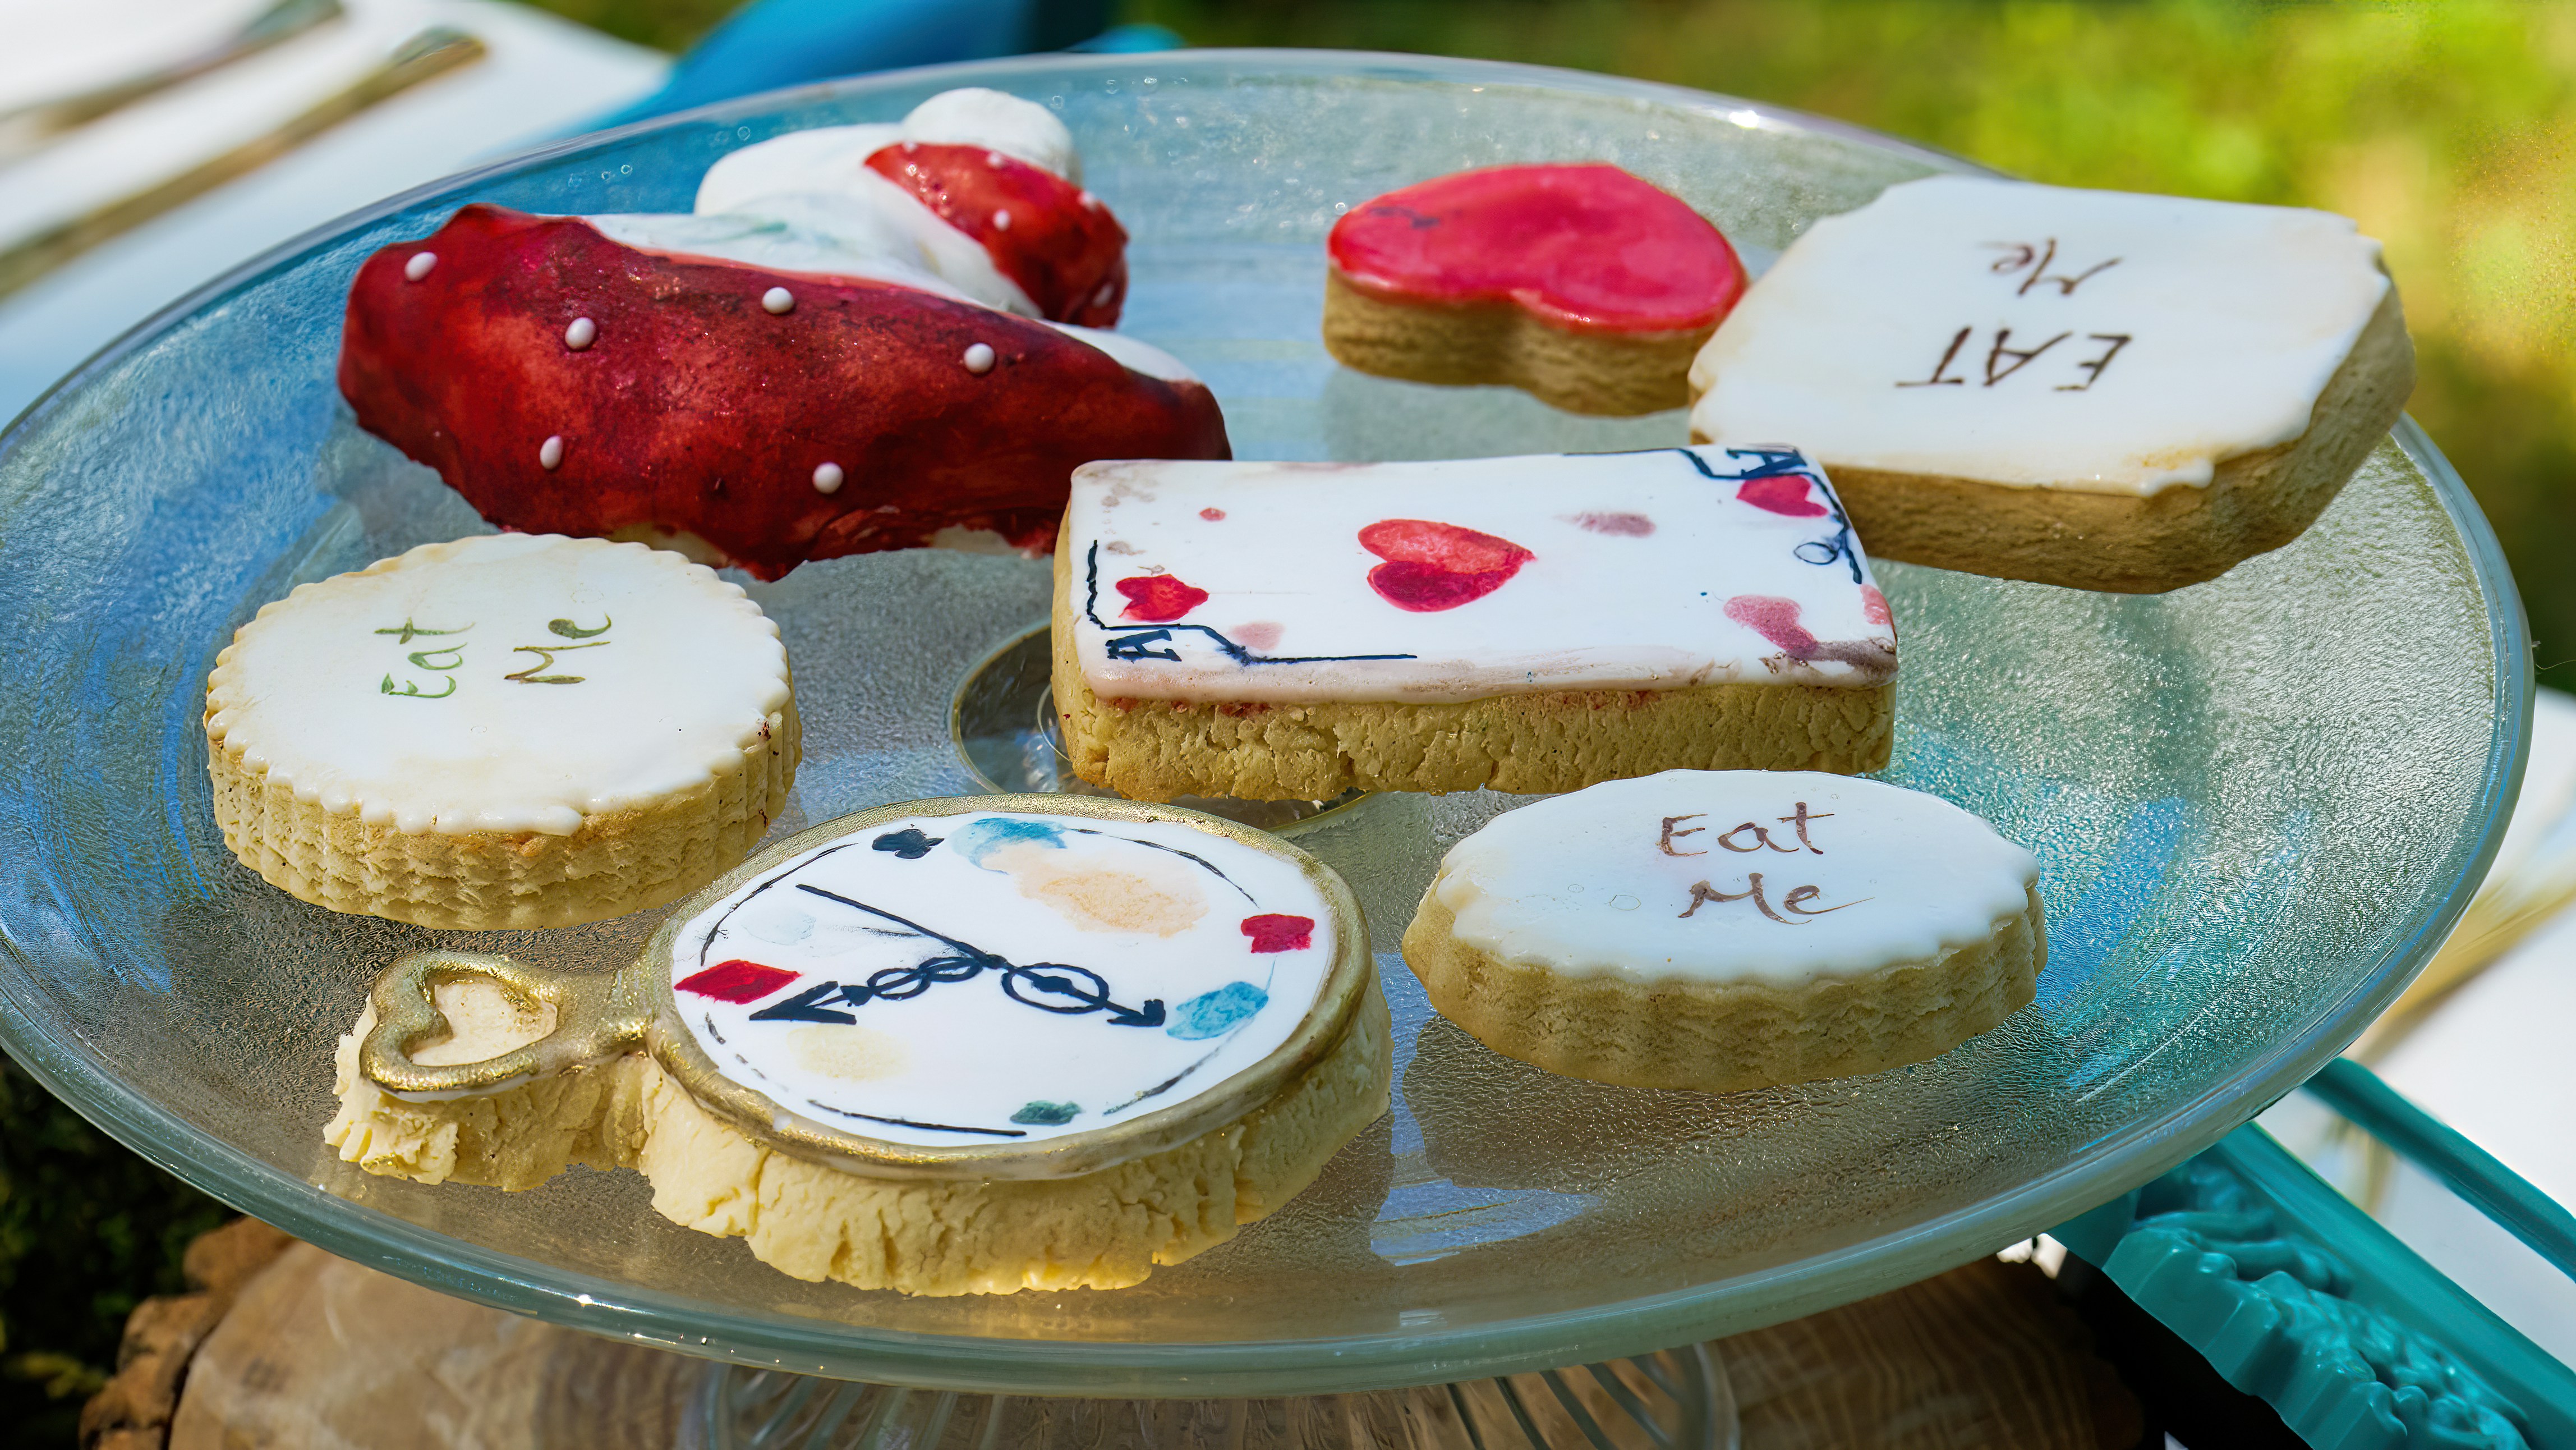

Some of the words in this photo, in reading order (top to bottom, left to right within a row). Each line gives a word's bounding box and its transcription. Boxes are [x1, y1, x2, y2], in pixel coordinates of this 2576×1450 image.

[1977, 237, 2124, 296] Me
[1893, 325, 2133, 392] EAT
[374, 616, 476, 699] Eat
[504, 612, 611, 684] Me
[1105, 629, 1183, 663] A
[1656, 802, 1834, 857] Eat
[1678, 873, 1875, 925] Me
